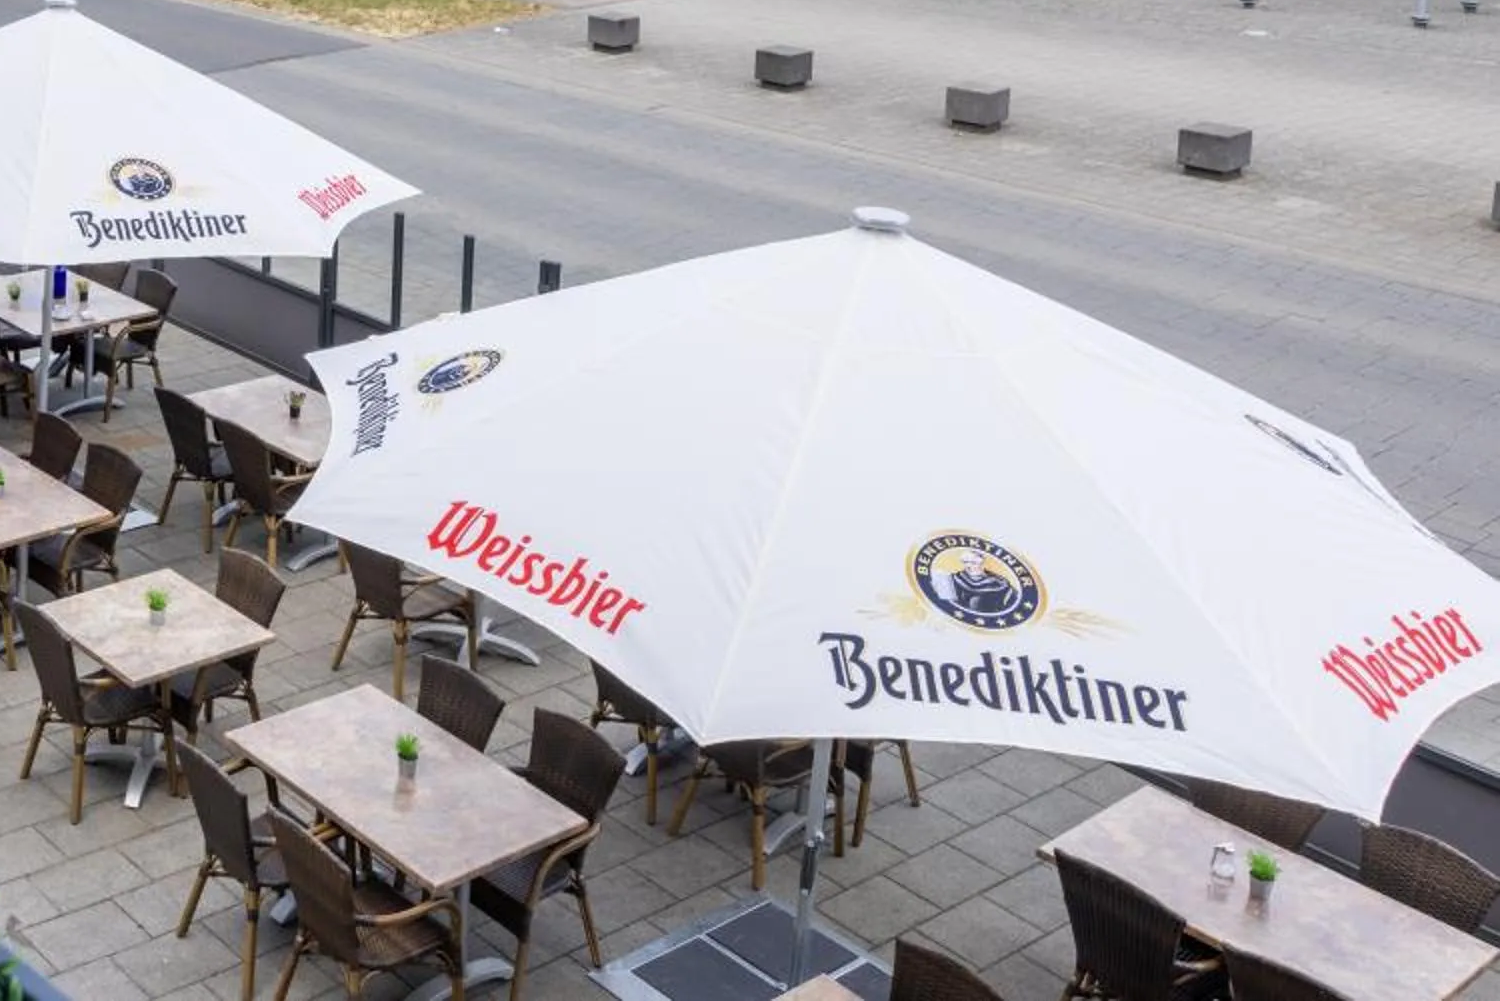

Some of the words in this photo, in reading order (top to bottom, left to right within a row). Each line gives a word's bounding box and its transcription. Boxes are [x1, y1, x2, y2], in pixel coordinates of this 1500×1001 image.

[69, 209, 248, 248] Benediktiner
[297, 174, 367, 218] Weissbier
[427, 500, 647, 635] Weissbier
[916, 535, 1034, 588] BENEDIKTINER
[818, 631, 1188, 732] Benediktiner
[1321, 607, 1483, 722] Weissbier
